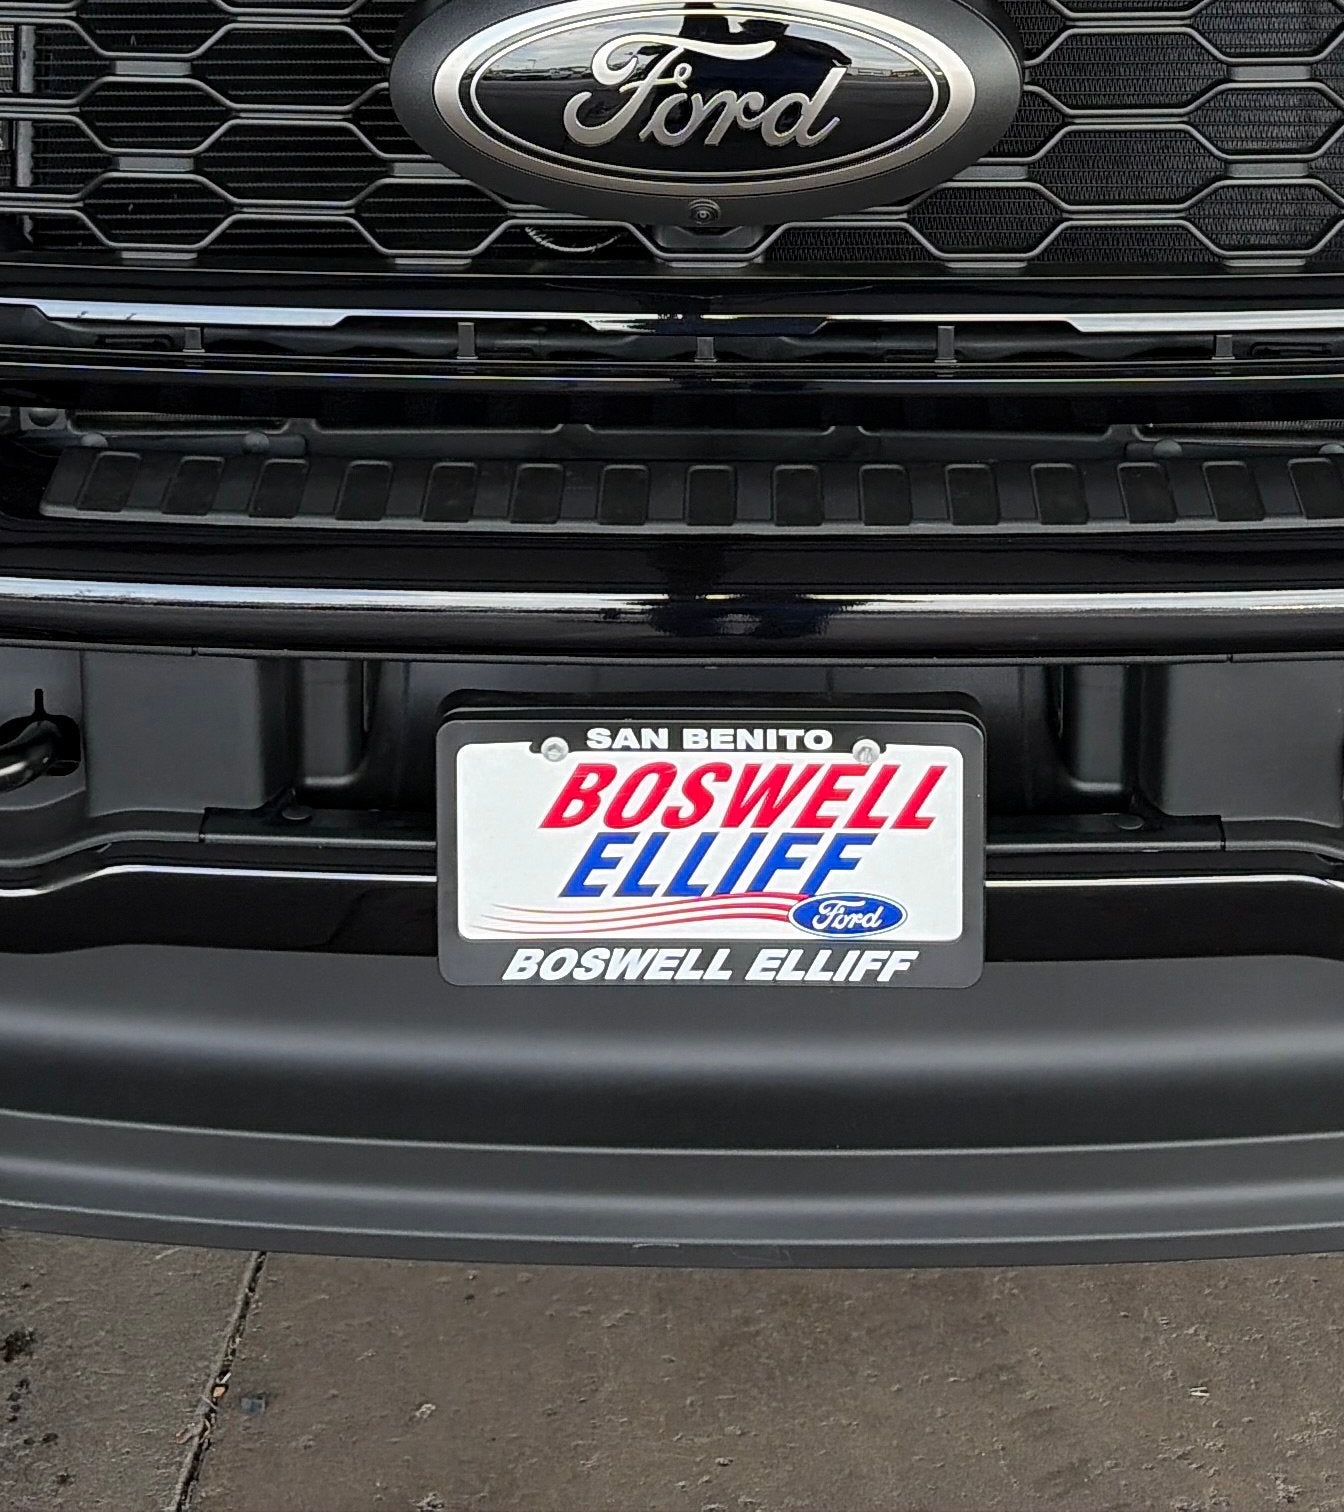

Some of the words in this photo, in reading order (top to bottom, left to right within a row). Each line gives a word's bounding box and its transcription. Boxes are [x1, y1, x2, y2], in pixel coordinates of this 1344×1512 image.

[563, 33, 848, 147] Ford
[586, 728, 669, 750] SAN
[682, 729, 833, 750] BENITO
[539, 763, 948, 830] BOSWELL
[558, 832, 878, 898] ELLIFF
[811, 898, 884, 931] Ford
[502, 948, 733, 981] BOSWELL
[744, 950, 920, 982] ELLIFF
